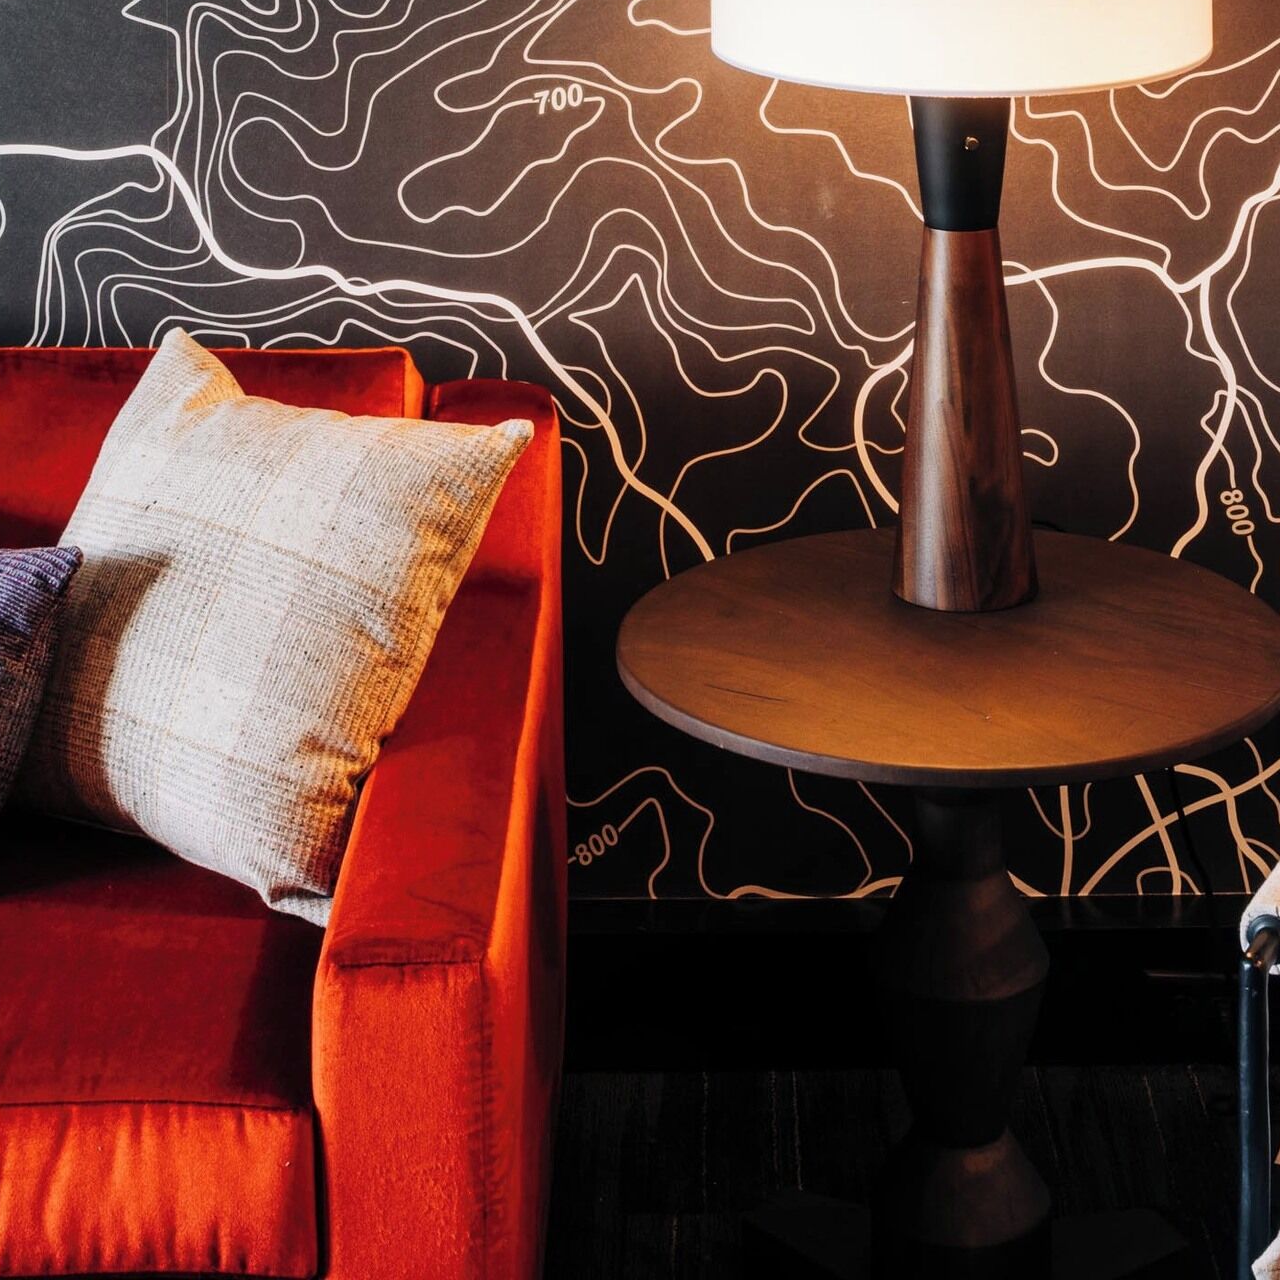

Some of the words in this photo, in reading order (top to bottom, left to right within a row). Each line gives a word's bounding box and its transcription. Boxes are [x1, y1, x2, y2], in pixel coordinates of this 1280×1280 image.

[535, 84, 584, 115] 700
[1220, 488, 1254, 536] 800
[575, 824, 618, 866] 800
